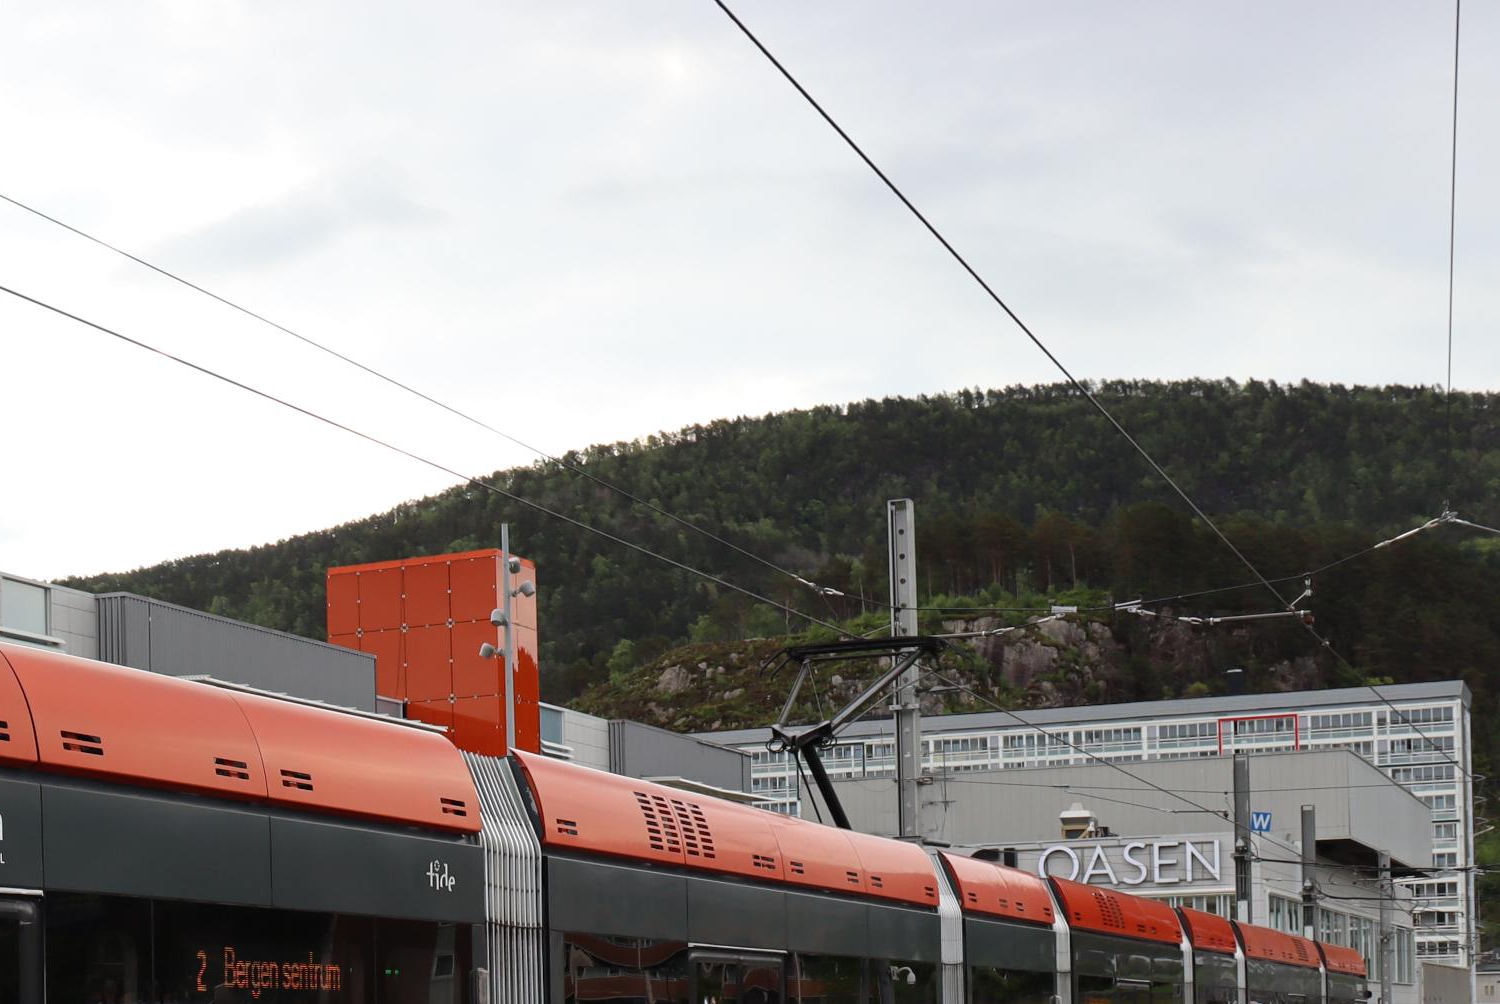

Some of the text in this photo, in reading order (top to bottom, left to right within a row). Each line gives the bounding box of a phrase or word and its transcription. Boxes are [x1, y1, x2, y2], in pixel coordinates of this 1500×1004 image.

[1252, 812, 1271, 830] W
[426, 859, 456, 891] tide
[1038, 839, 1221, 885] OASEN
[196, 946, 341, 999] 2 Bergen sentrum
